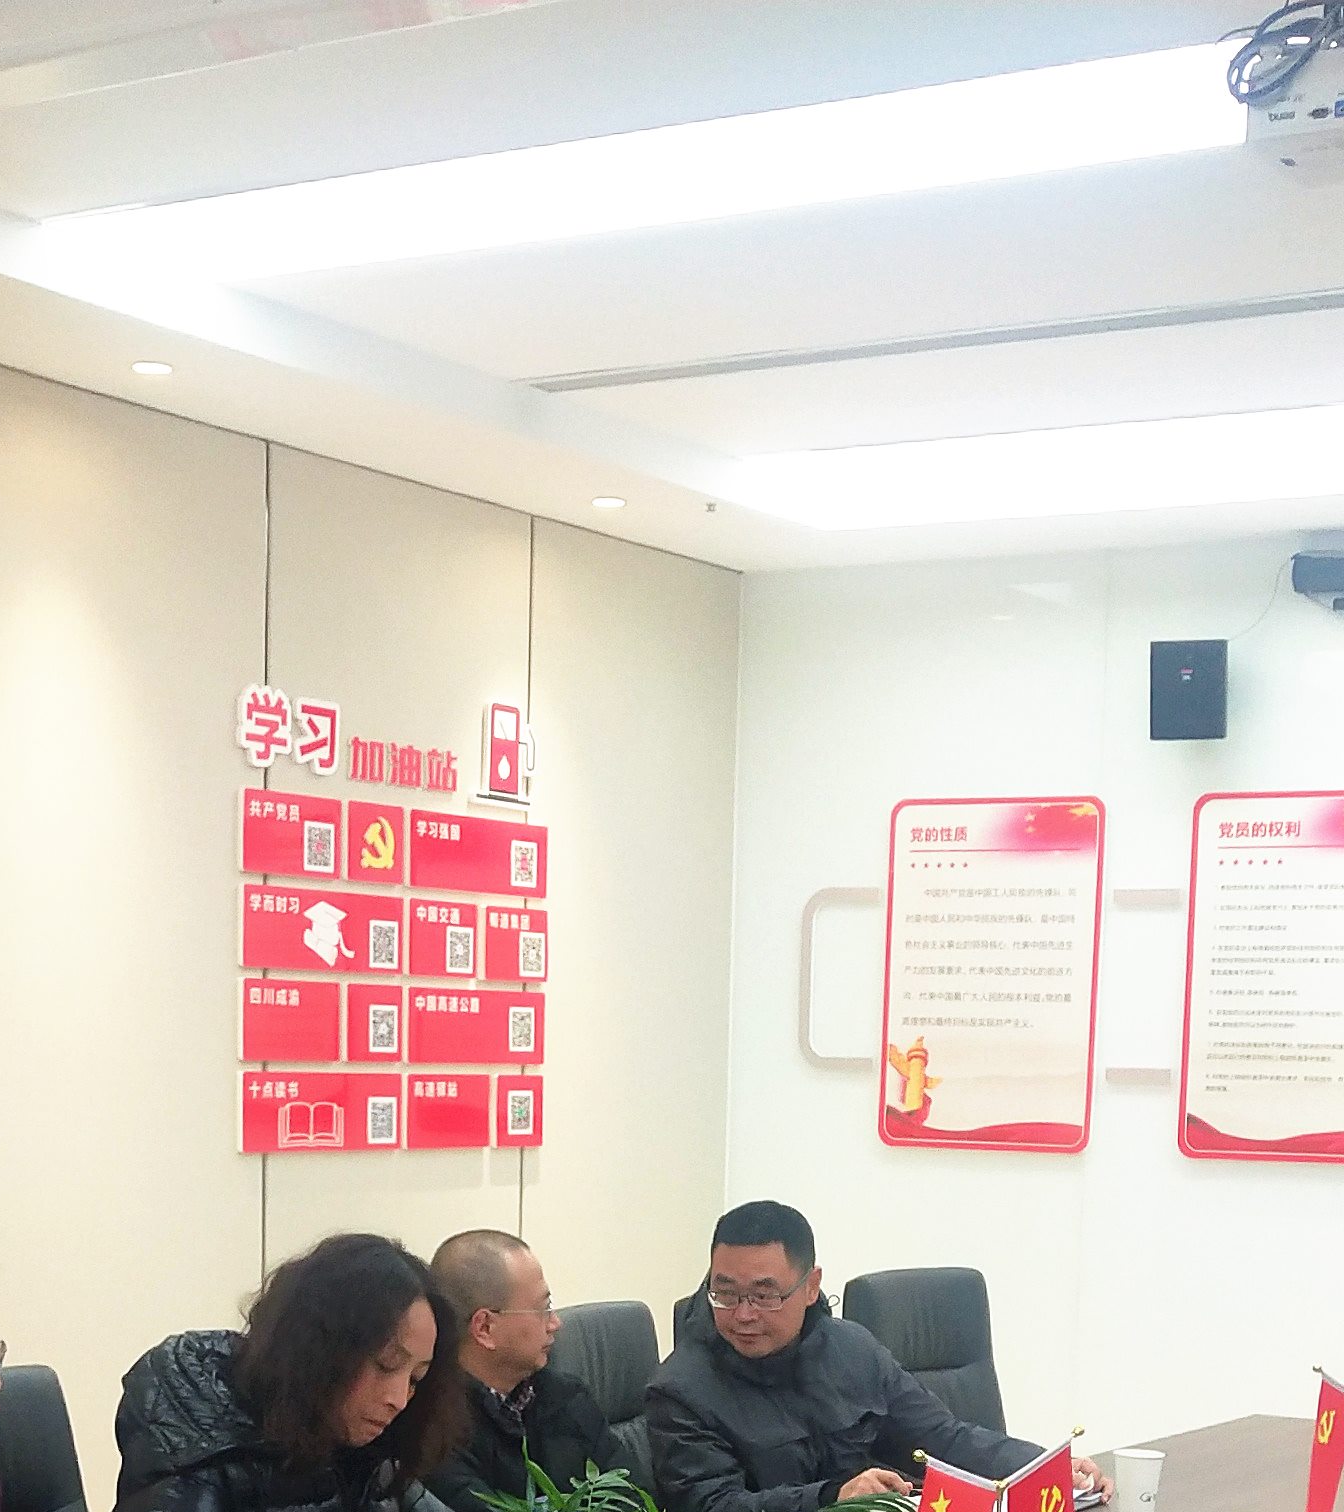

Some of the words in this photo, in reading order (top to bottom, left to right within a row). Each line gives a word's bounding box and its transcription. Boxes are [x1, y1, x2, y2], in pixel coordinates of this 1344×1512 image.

[243, 690, 339, 770] 学习
[348, 735, 459, 793] 加油站
[248, 799, 301, 823] 共产党员
[910, 826, 968, 843] 党的性质
[1218, 820, 1301, 839] 党员的权利
